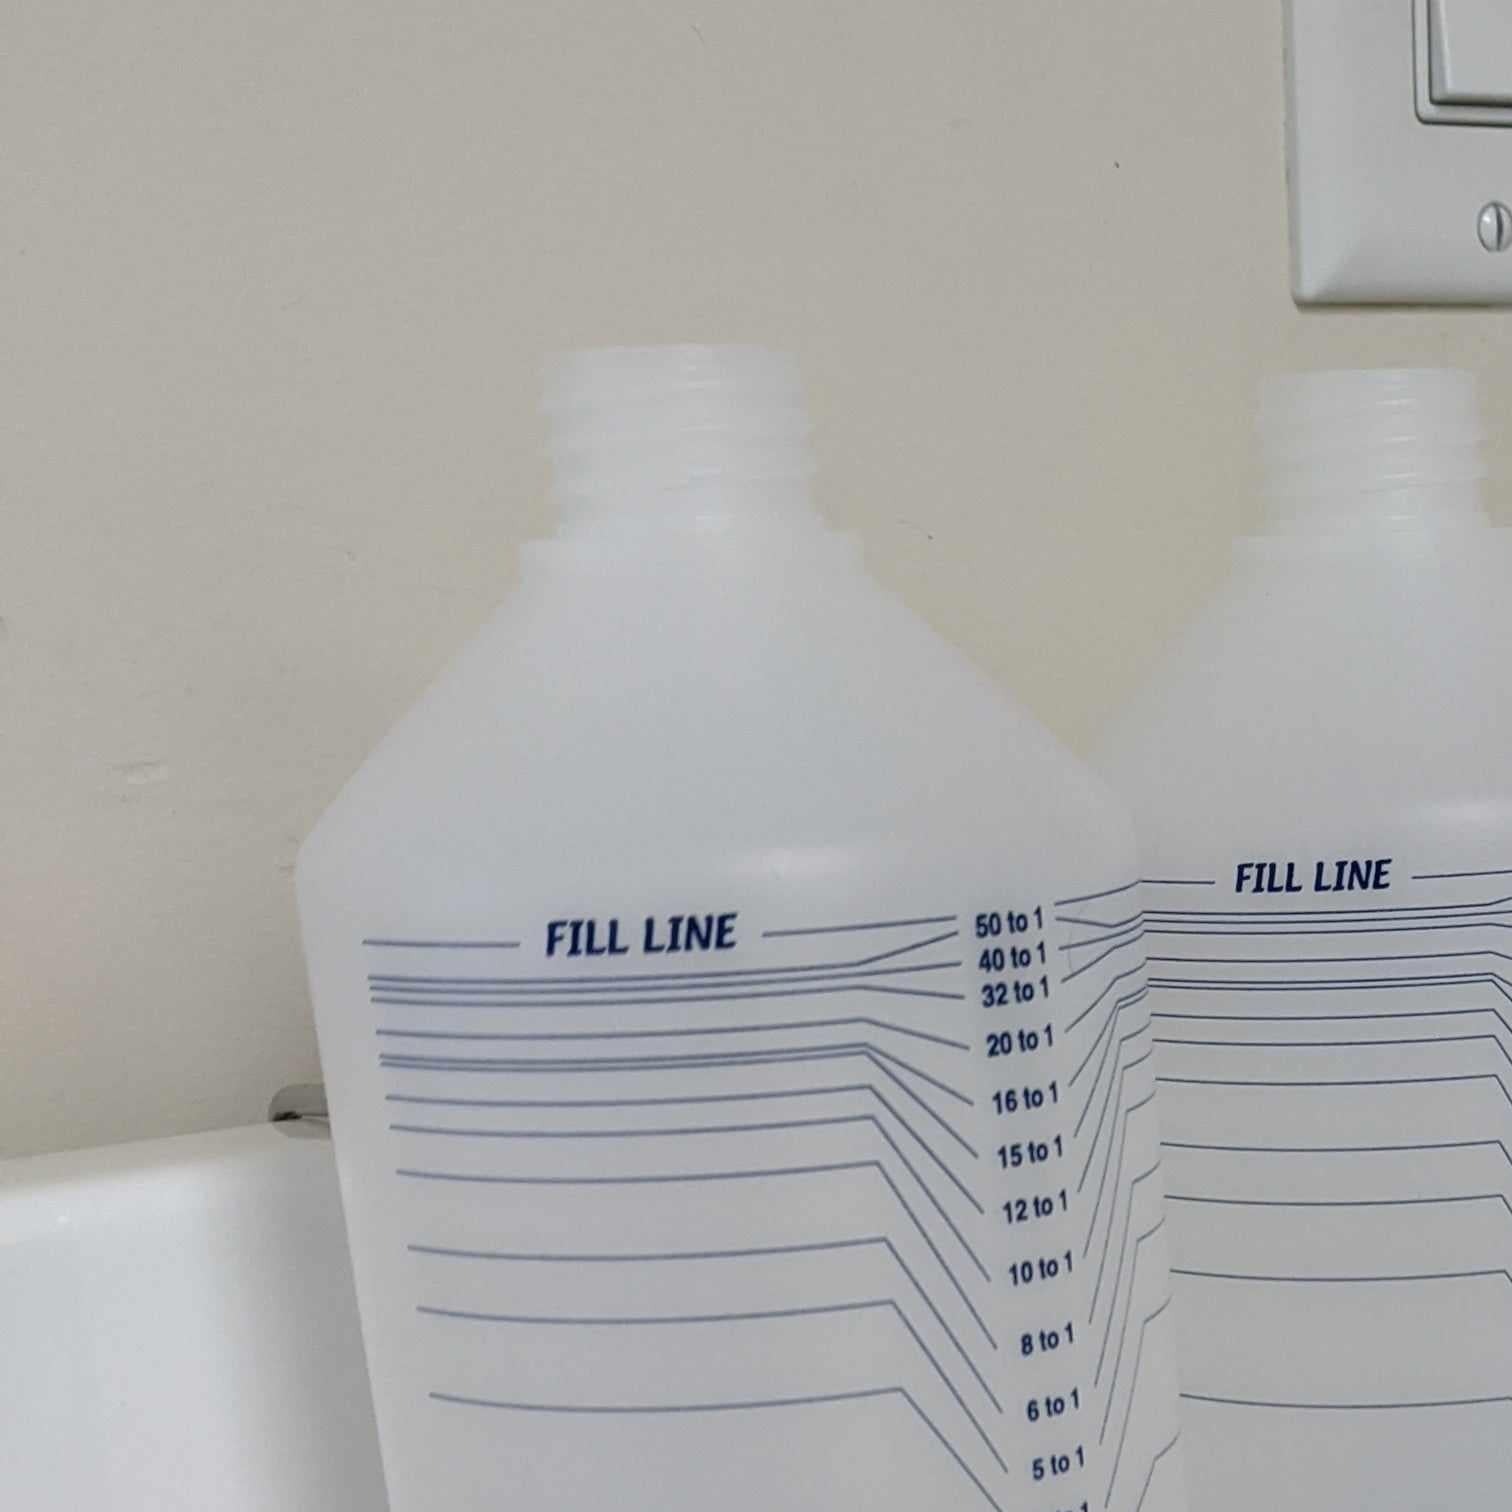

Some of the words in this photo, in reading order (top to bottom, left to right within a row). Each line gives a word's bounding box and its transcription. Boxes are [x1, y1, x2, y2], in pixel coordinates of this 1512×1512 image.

[1235, 861, 1303, 893] FILL
[1313, 858, 1392, 892] LINE
[547, 920, 629, 956] FILL
[643, 914, 738, 953] LINE
[975, 911, 1003, 939] 50
[1006, 910, 1029, 935] to
[1033, 905, 1043, 930] 1
[978, 947, 1006, 973] 40
[1009, 945, 1032, 969] to
[1036, 940, 1046, 964] 1
[981, 981, 1009, 1009] 32
[1012, 980, 1035, 1004] to
[1039, 975, 1049, 998] 1
[985, 1030, 1013, 1058] 20
[1017, 1028, 1039, 1053] to
[1043, 1023, 1053, 1047] 1
[991, 1088, 1019, 1116] 16
[1022, 1086, 1044, 1110] to
[1048, 1080, 1058, 1104] 1
[997, 1142, 1024, 1169] 15
[1027, 1140, 1049, 1164] to
[1053, 1134, 1063, 1158] 1
[1002, 1198, 1029, 1225] 12
[1032, 1195, 1054, 1219] to
[1058, 1188, 1068, 1212] 1
[1008, 1260, 1034, 1287] 10
[1037, 1257, 1059, 1281] to
[1063, 1249, 1073, 1273] 1
[1020, 1332, 1034, 1357] 8
[1038, 1329, 1060, 1352] to
[1064, 1321, 1074, 1344] 1
[1026, 1399, 1040, 1423] 6
[1044, 1396, 1066, 1418] to
[1070, 1387, 1079, 1409] 1
[1031, 1457, 1045, 1481] 5
[1049, 1454, 1071, 1476] to
[1075, 1445, 1085, 1468] 1
